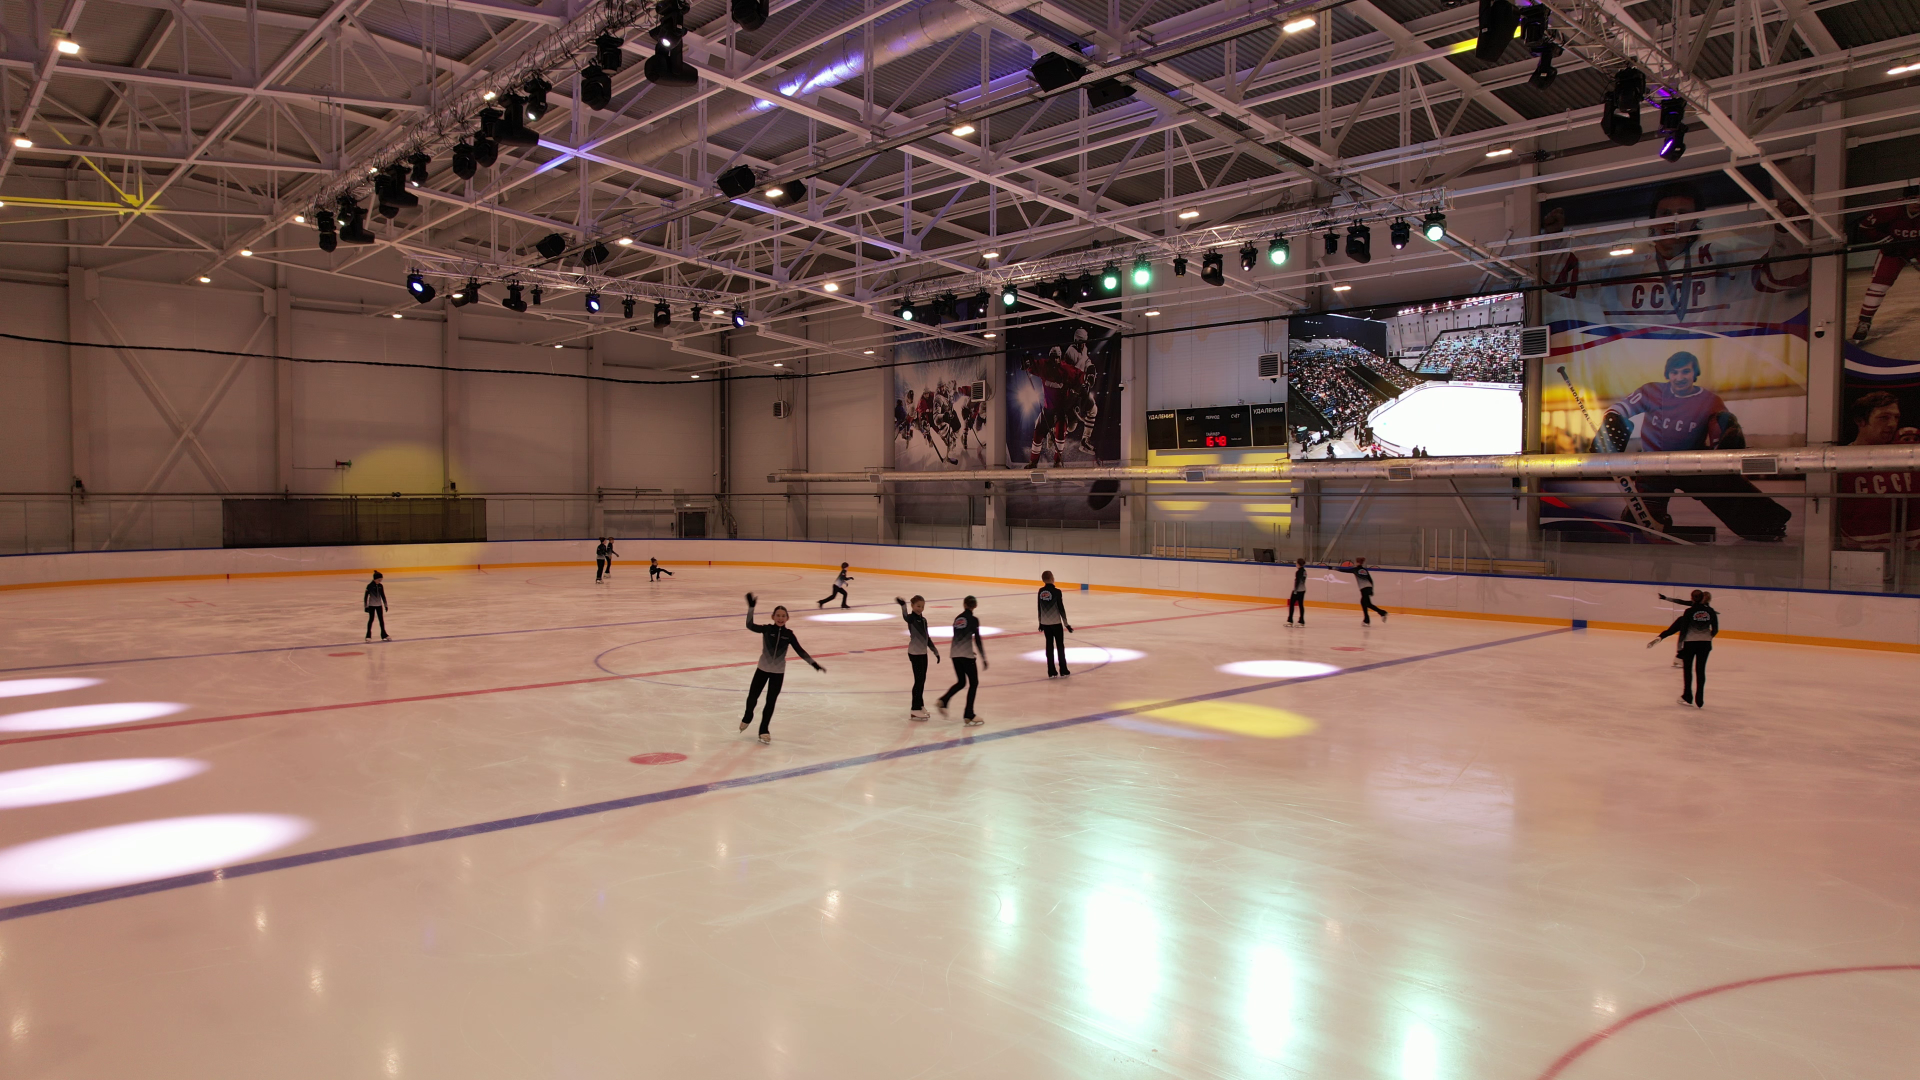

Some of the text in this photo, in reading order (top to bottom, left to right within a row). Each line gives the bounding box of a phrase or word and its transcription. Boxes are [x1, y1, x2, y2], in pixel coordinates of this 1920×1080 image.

[1894, 228, 1920, 238] ССС
[1253, 407, 1283, 415] УДАЛЕНИЯ
[1569, 386, 1590, 421] MONTREAL
[1651, 415, 1697, 433] СССР
[1854, 472, 1912, 494] СССР
